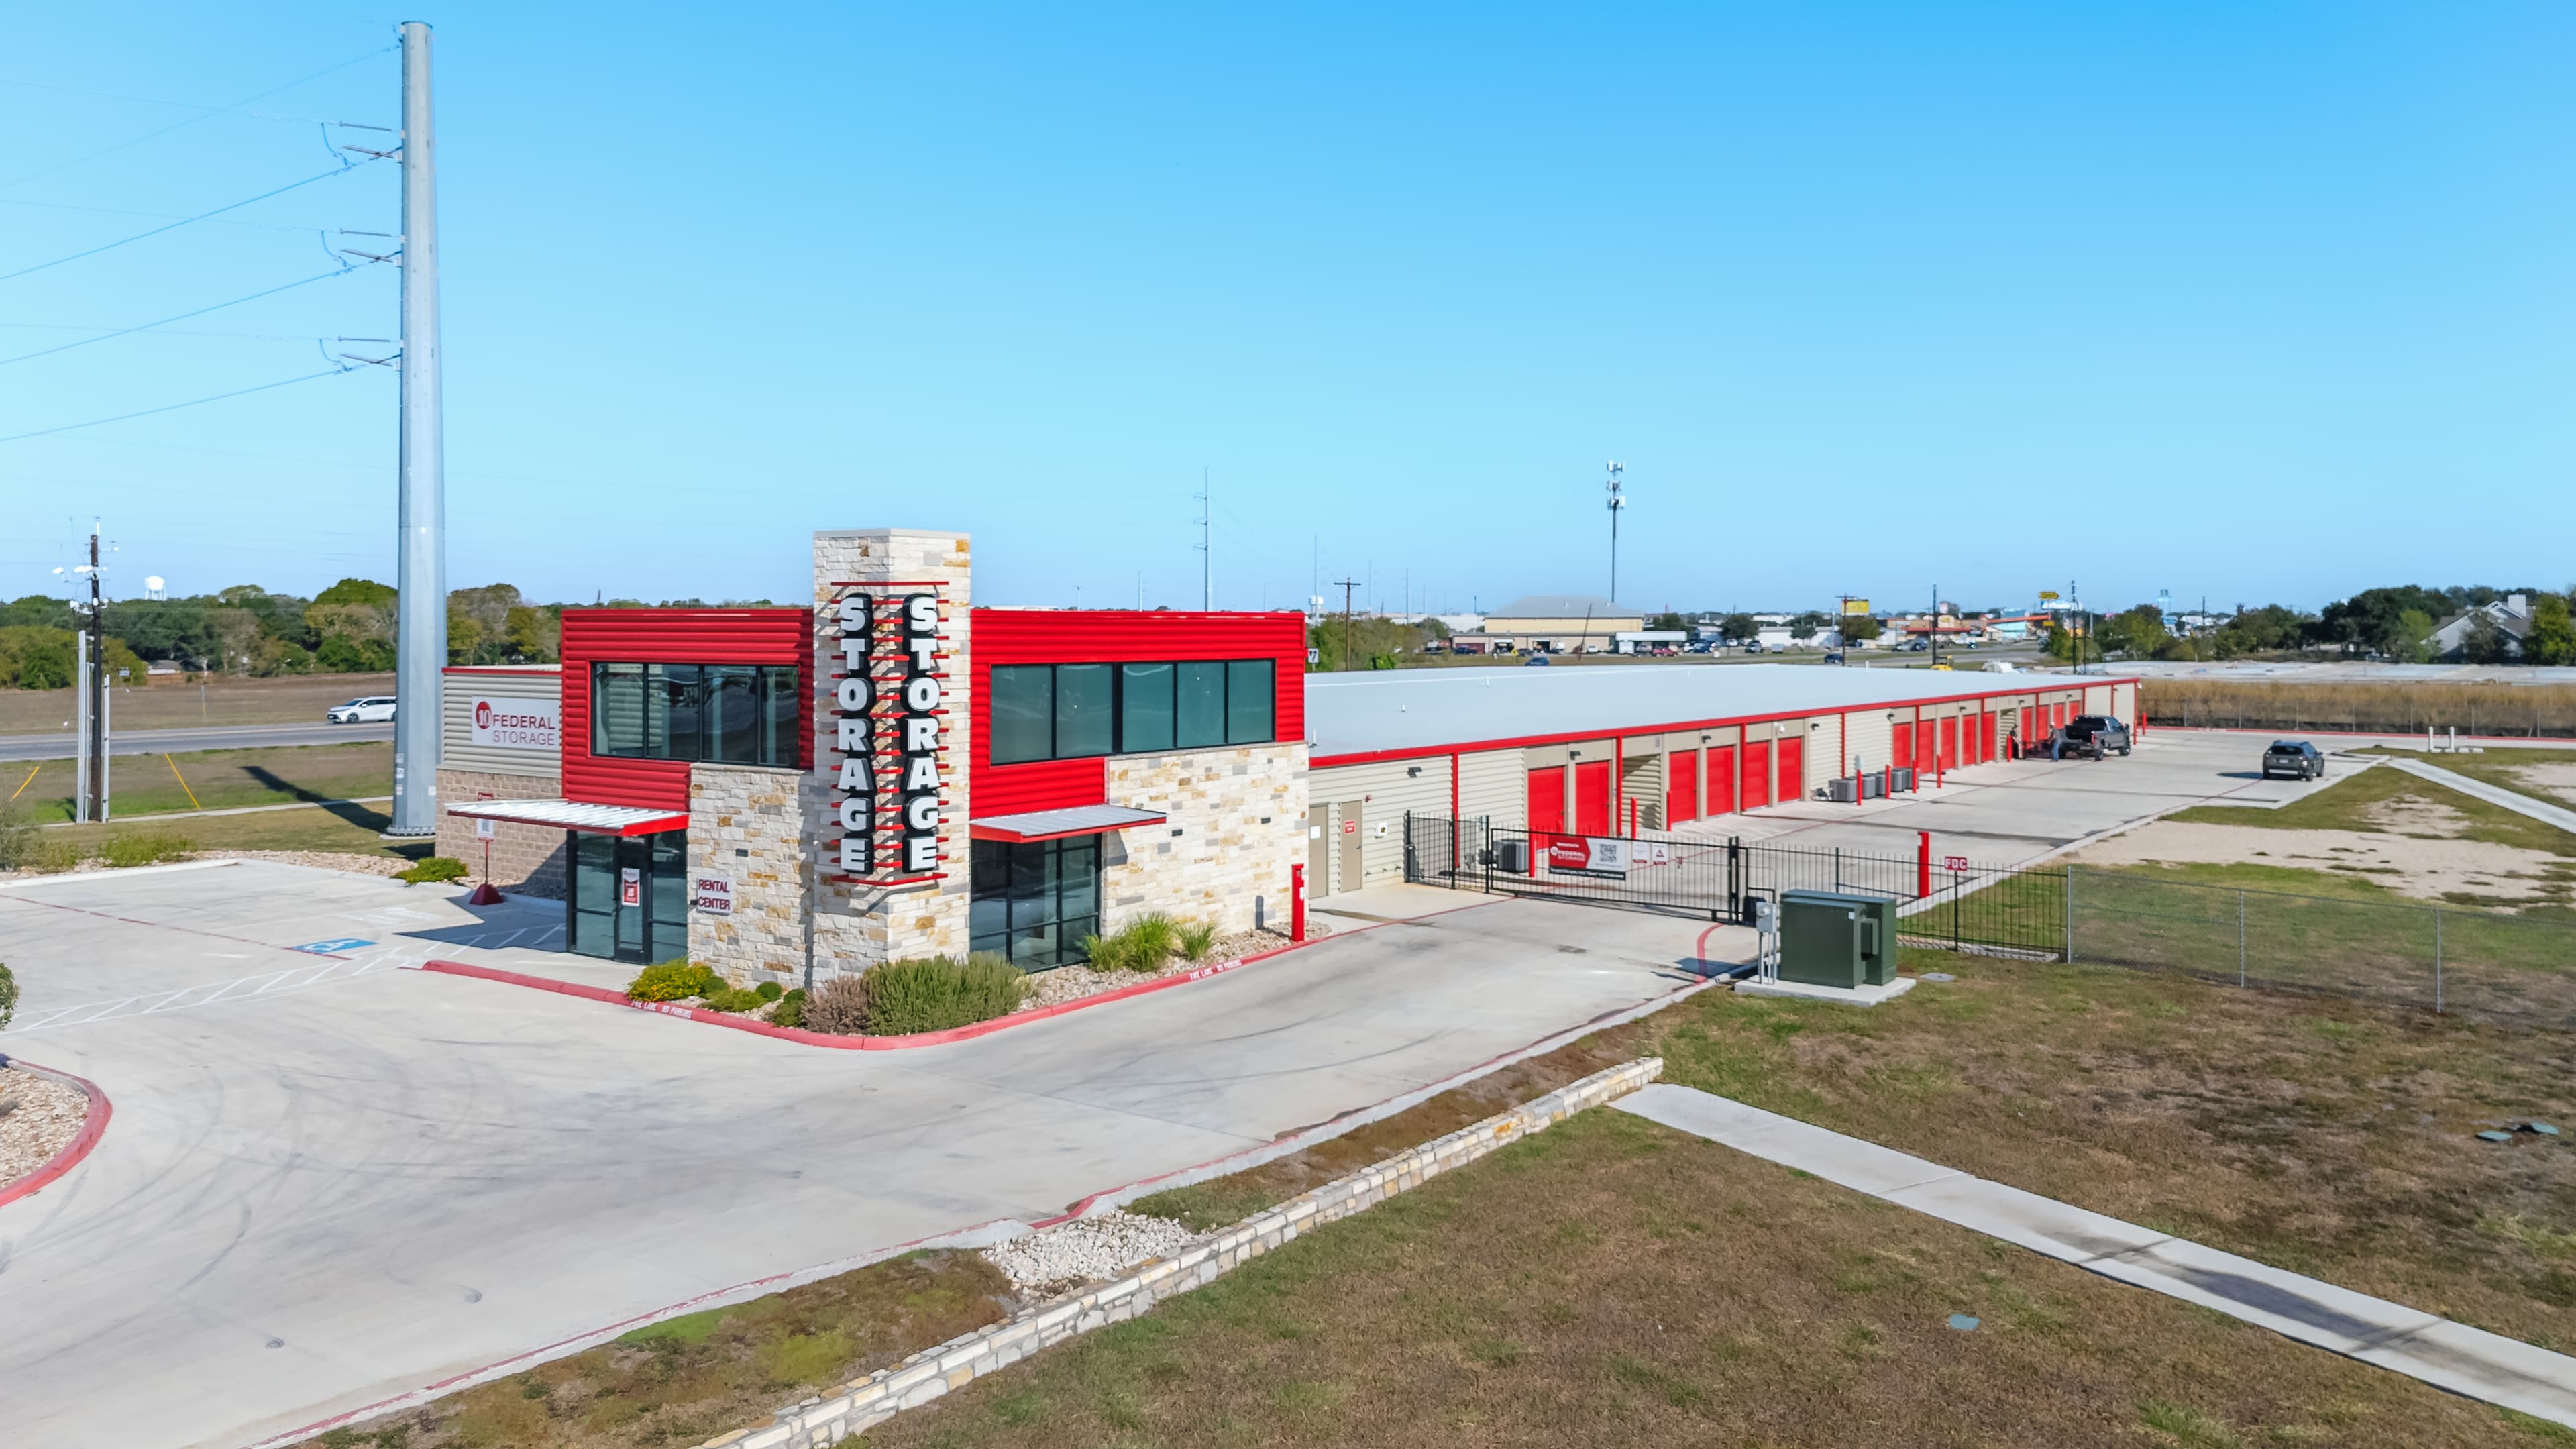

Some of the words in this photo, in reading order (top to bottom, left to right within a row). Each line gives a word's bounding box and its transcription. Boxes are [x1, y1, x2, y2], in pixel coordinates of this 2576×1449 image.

[478, 709, 492, 726] 10
[492, 714, 556, 730] FEDERAL
[493, 730, 555, 746] STORAGE
[837, 596, 871, 872] STORAGE
[908, 596, 940, 872] STORAGE
[1945, 858, 1966, 870] FDC
[698, 879, 730, 893] RENTAL
[698, 896, 731, 910] CENTER
